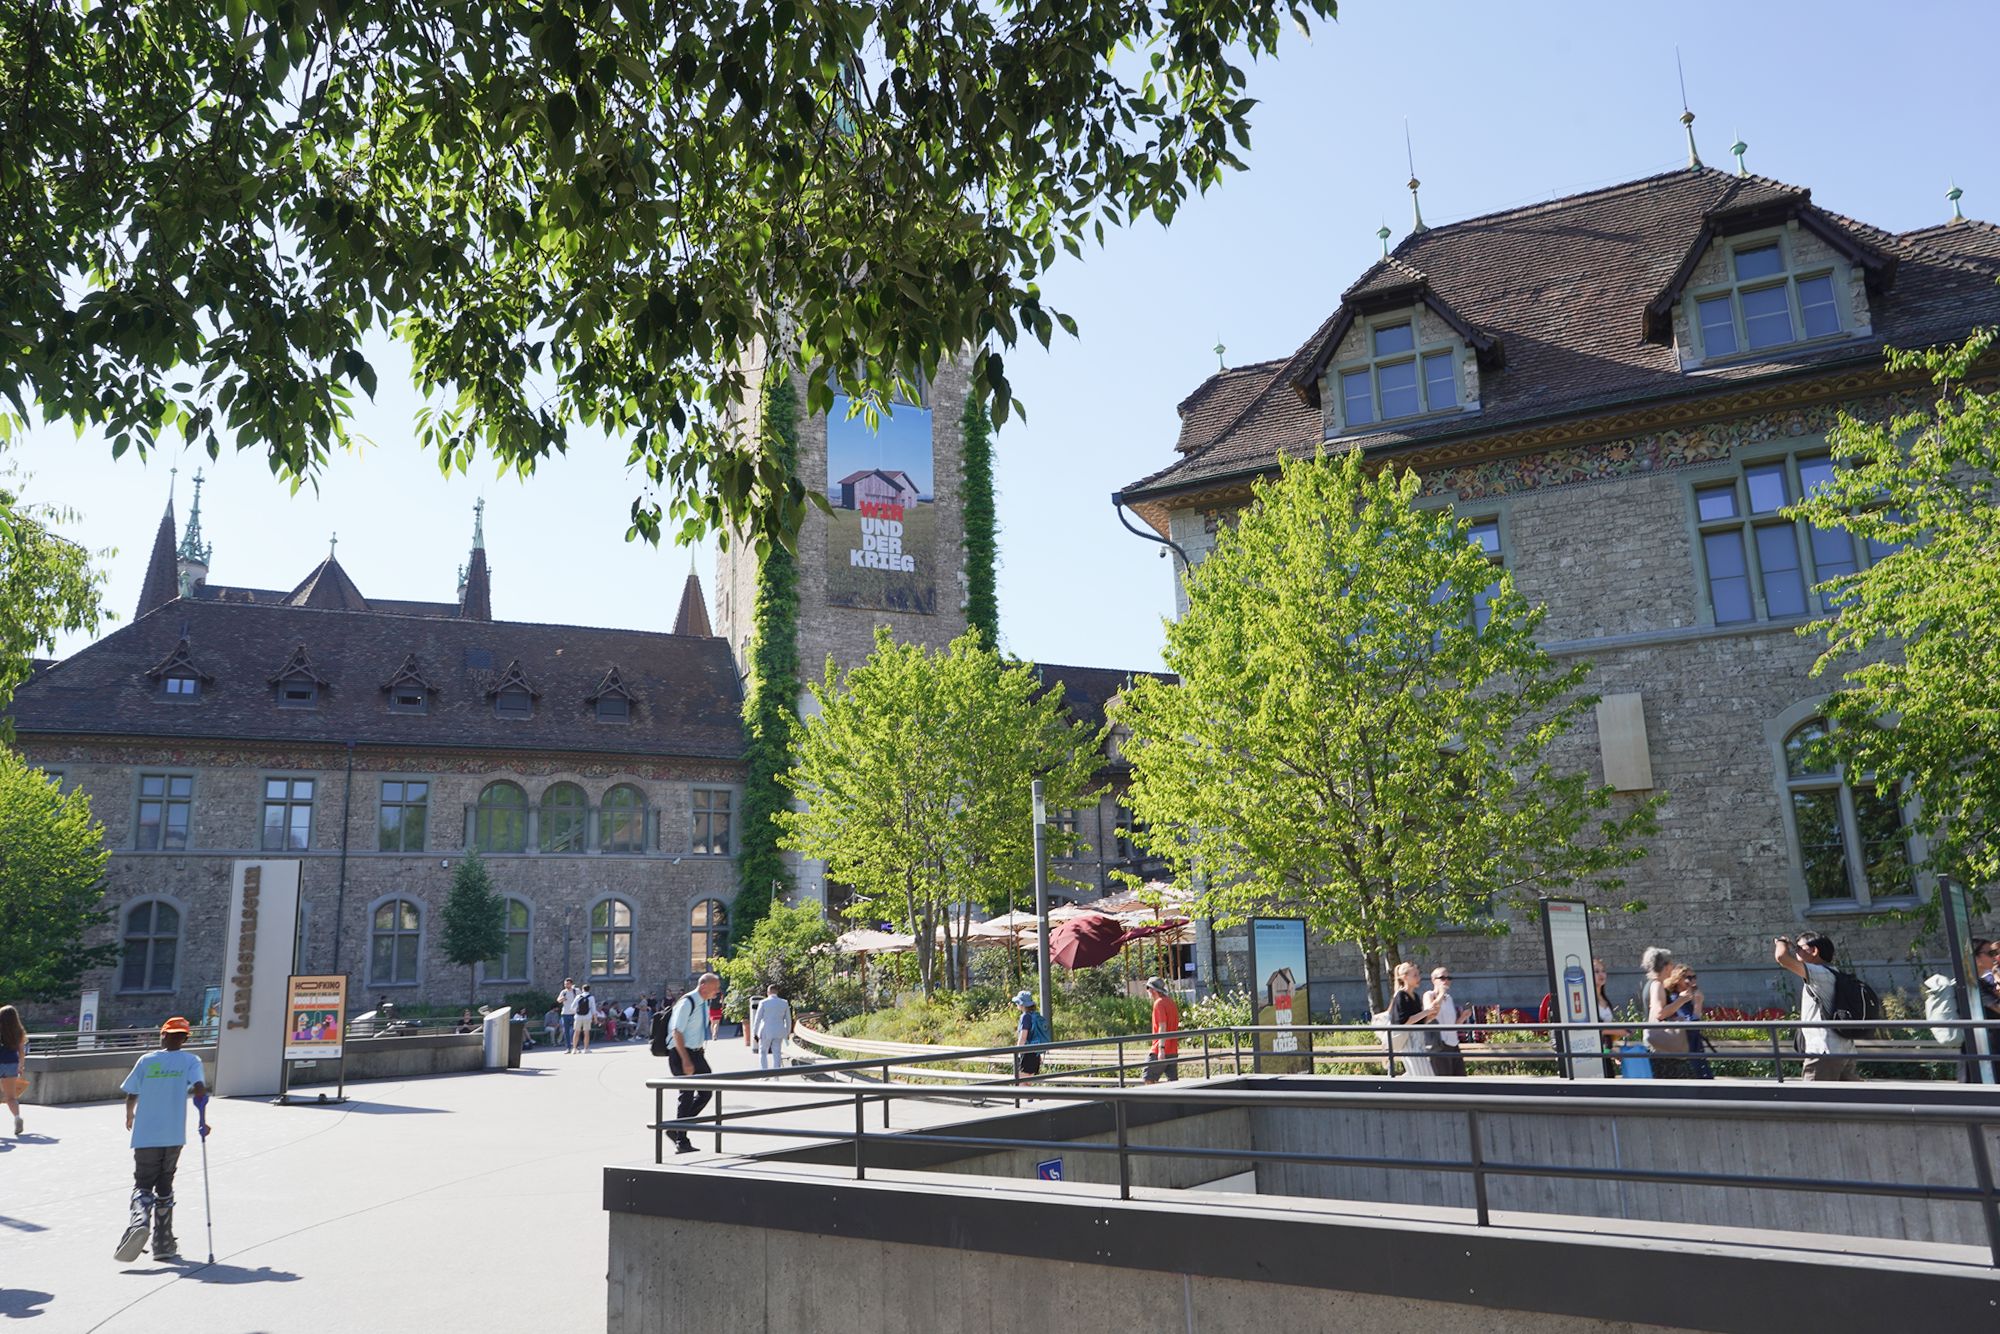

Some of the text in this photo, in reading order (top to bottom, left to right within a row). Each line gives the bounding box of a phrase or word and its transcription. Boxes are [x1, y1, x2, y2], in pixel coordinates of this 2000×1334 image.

[860, 500, 904, 522] WIR
[860, 517, 903, 538] UND
[862, 534, 902, 554] DER
[850, 549, 915, 572] KRIEG
[227, 865, 261, 1030] Landesmuseum
[295, 982, 340, 990] HOFKINO
[1275, 1009, 1292, 1024] UND
[1273, 1037, 1298, 1053] KRIEG
